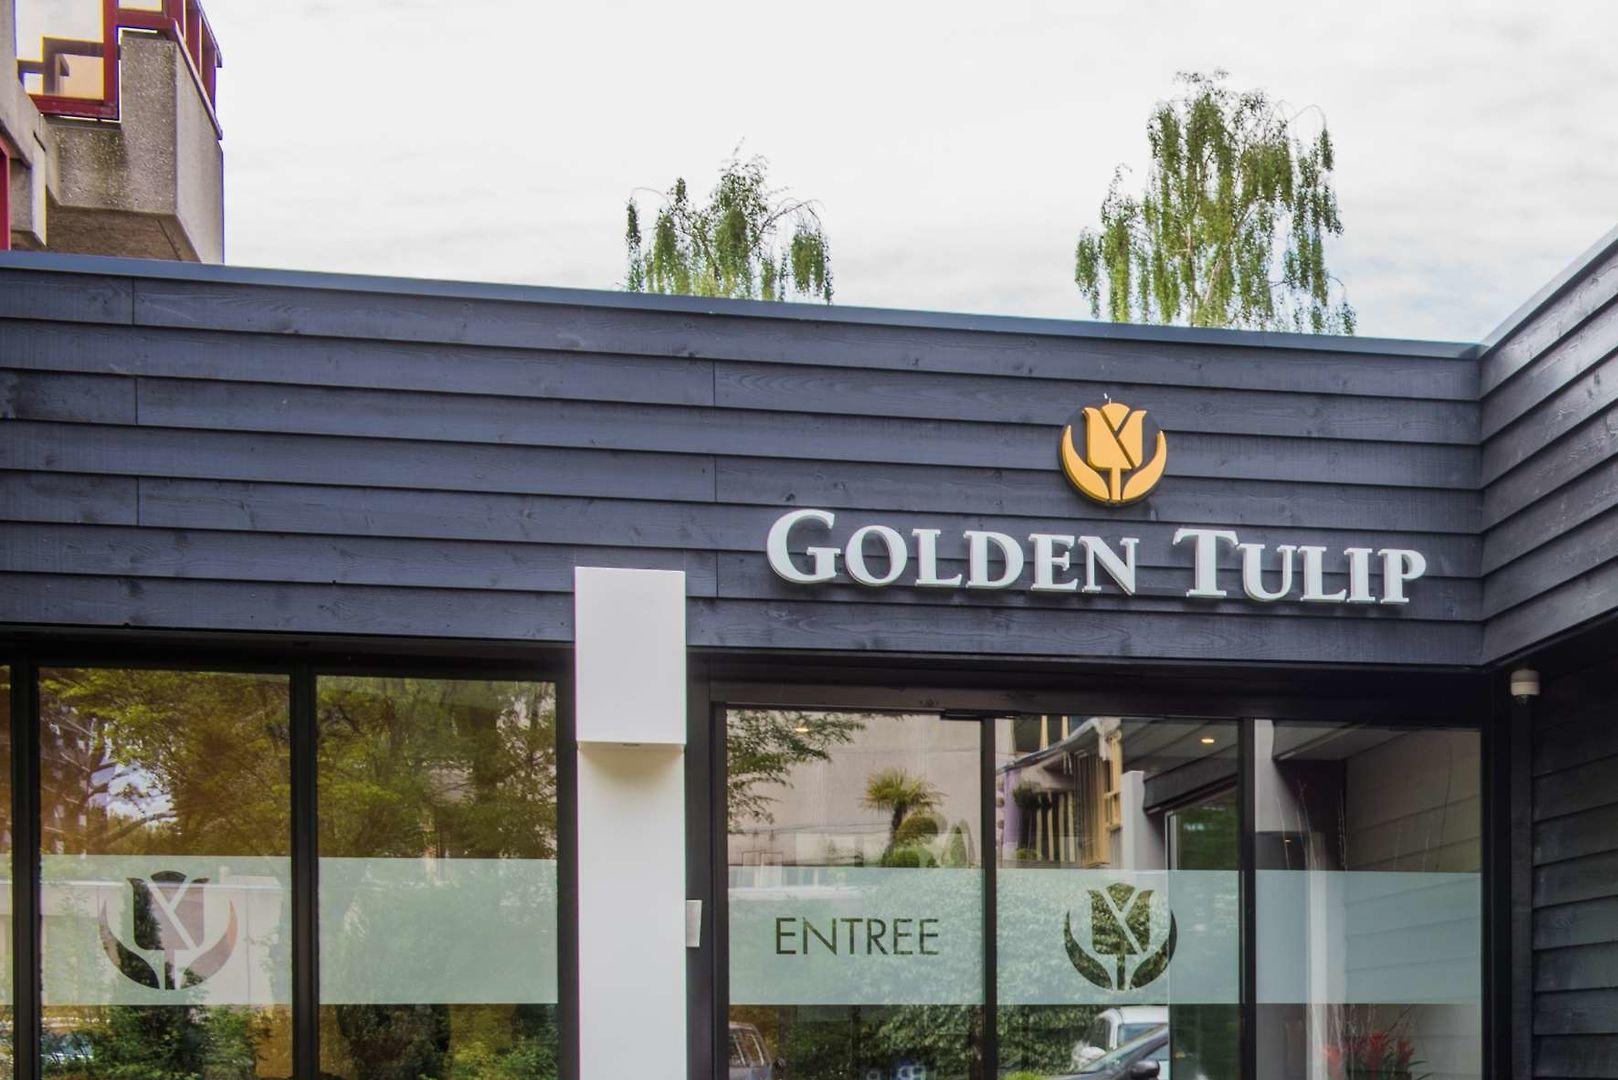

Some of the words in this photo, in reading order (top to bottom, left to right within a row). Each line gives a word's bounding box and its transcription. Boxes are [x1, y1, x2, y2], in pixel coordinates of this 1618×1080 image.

[766, 508, 1140, 596] GOLDEN
[1172, 528, 1427, 604] TULIP
[775, 917, 939, 956] ENTREE
